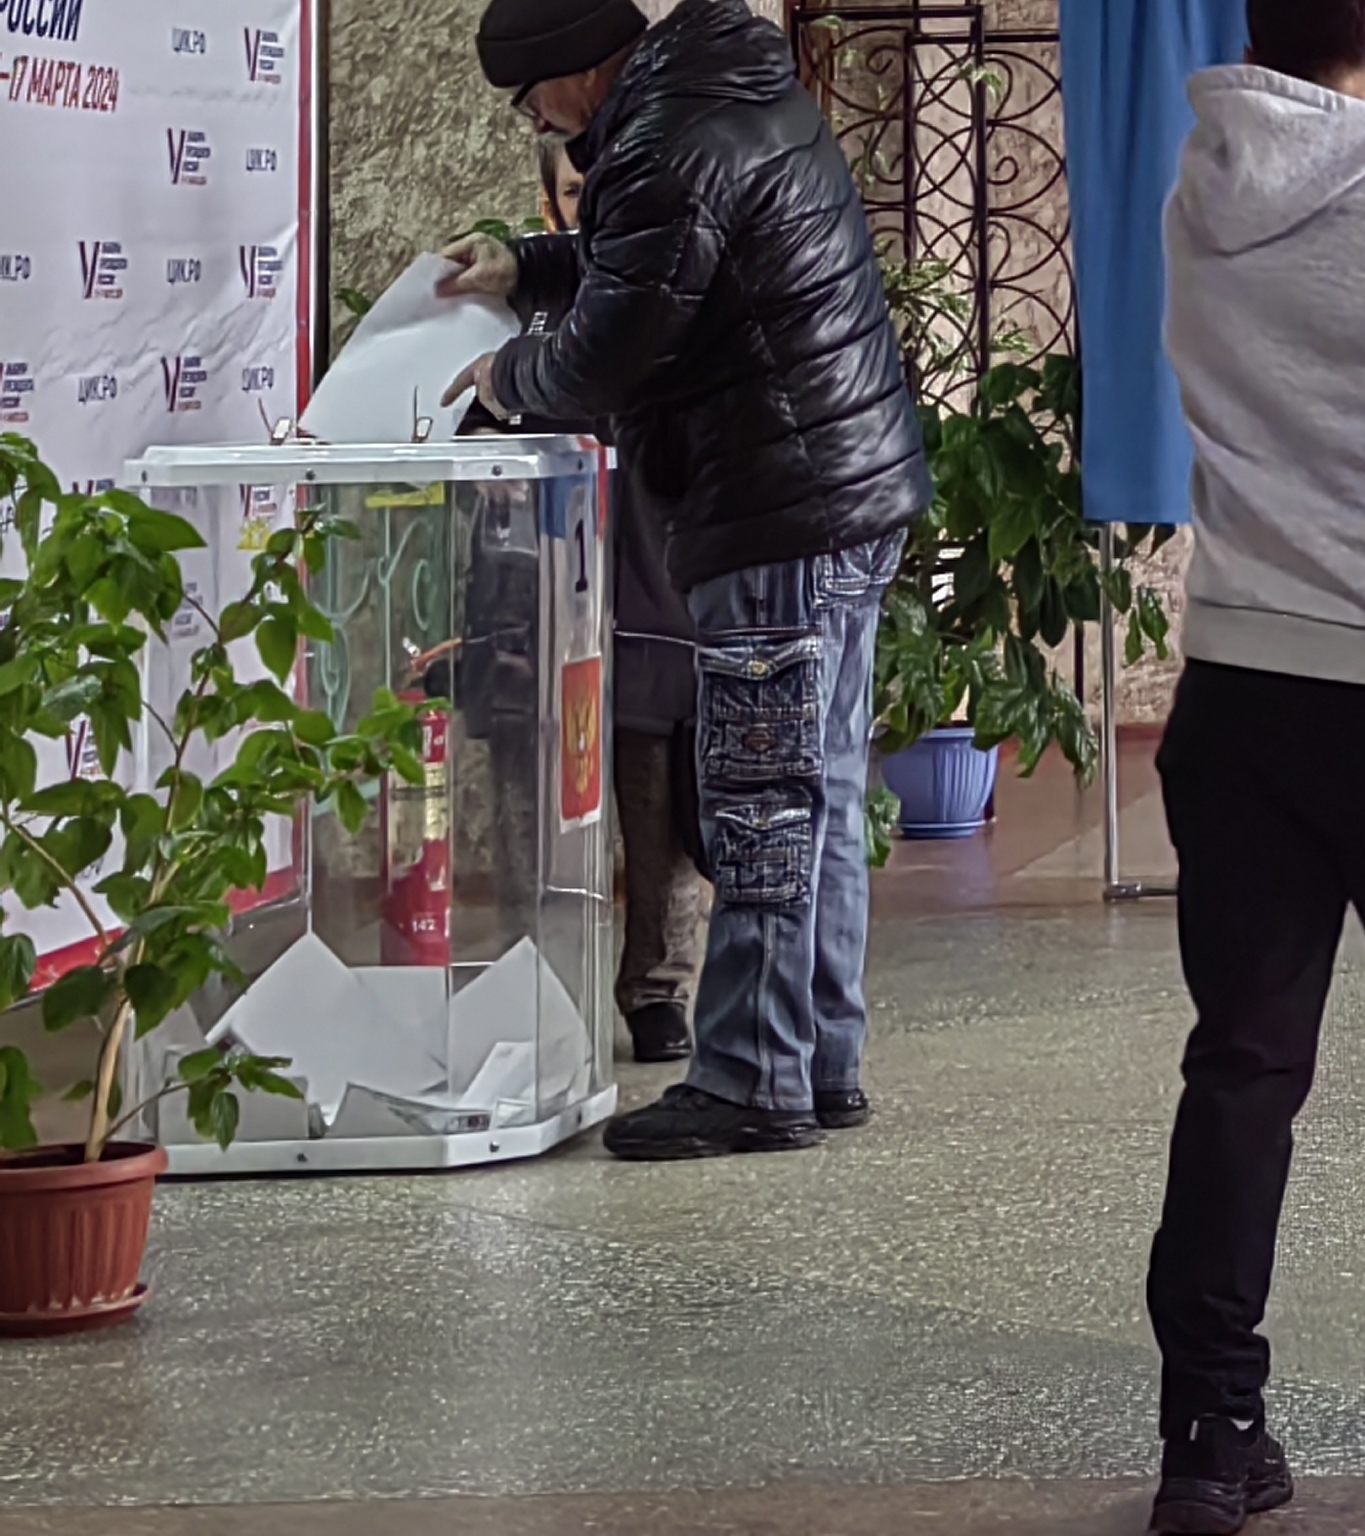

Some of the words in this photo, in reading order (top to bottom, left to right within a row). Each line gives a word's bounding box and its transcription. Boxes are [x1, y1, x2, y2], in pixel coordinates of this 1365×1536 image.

[27, 57, 81, 107] МАРТА
[82, 65, 119, 113] 2024
[574, 519, 588, 594] 1
